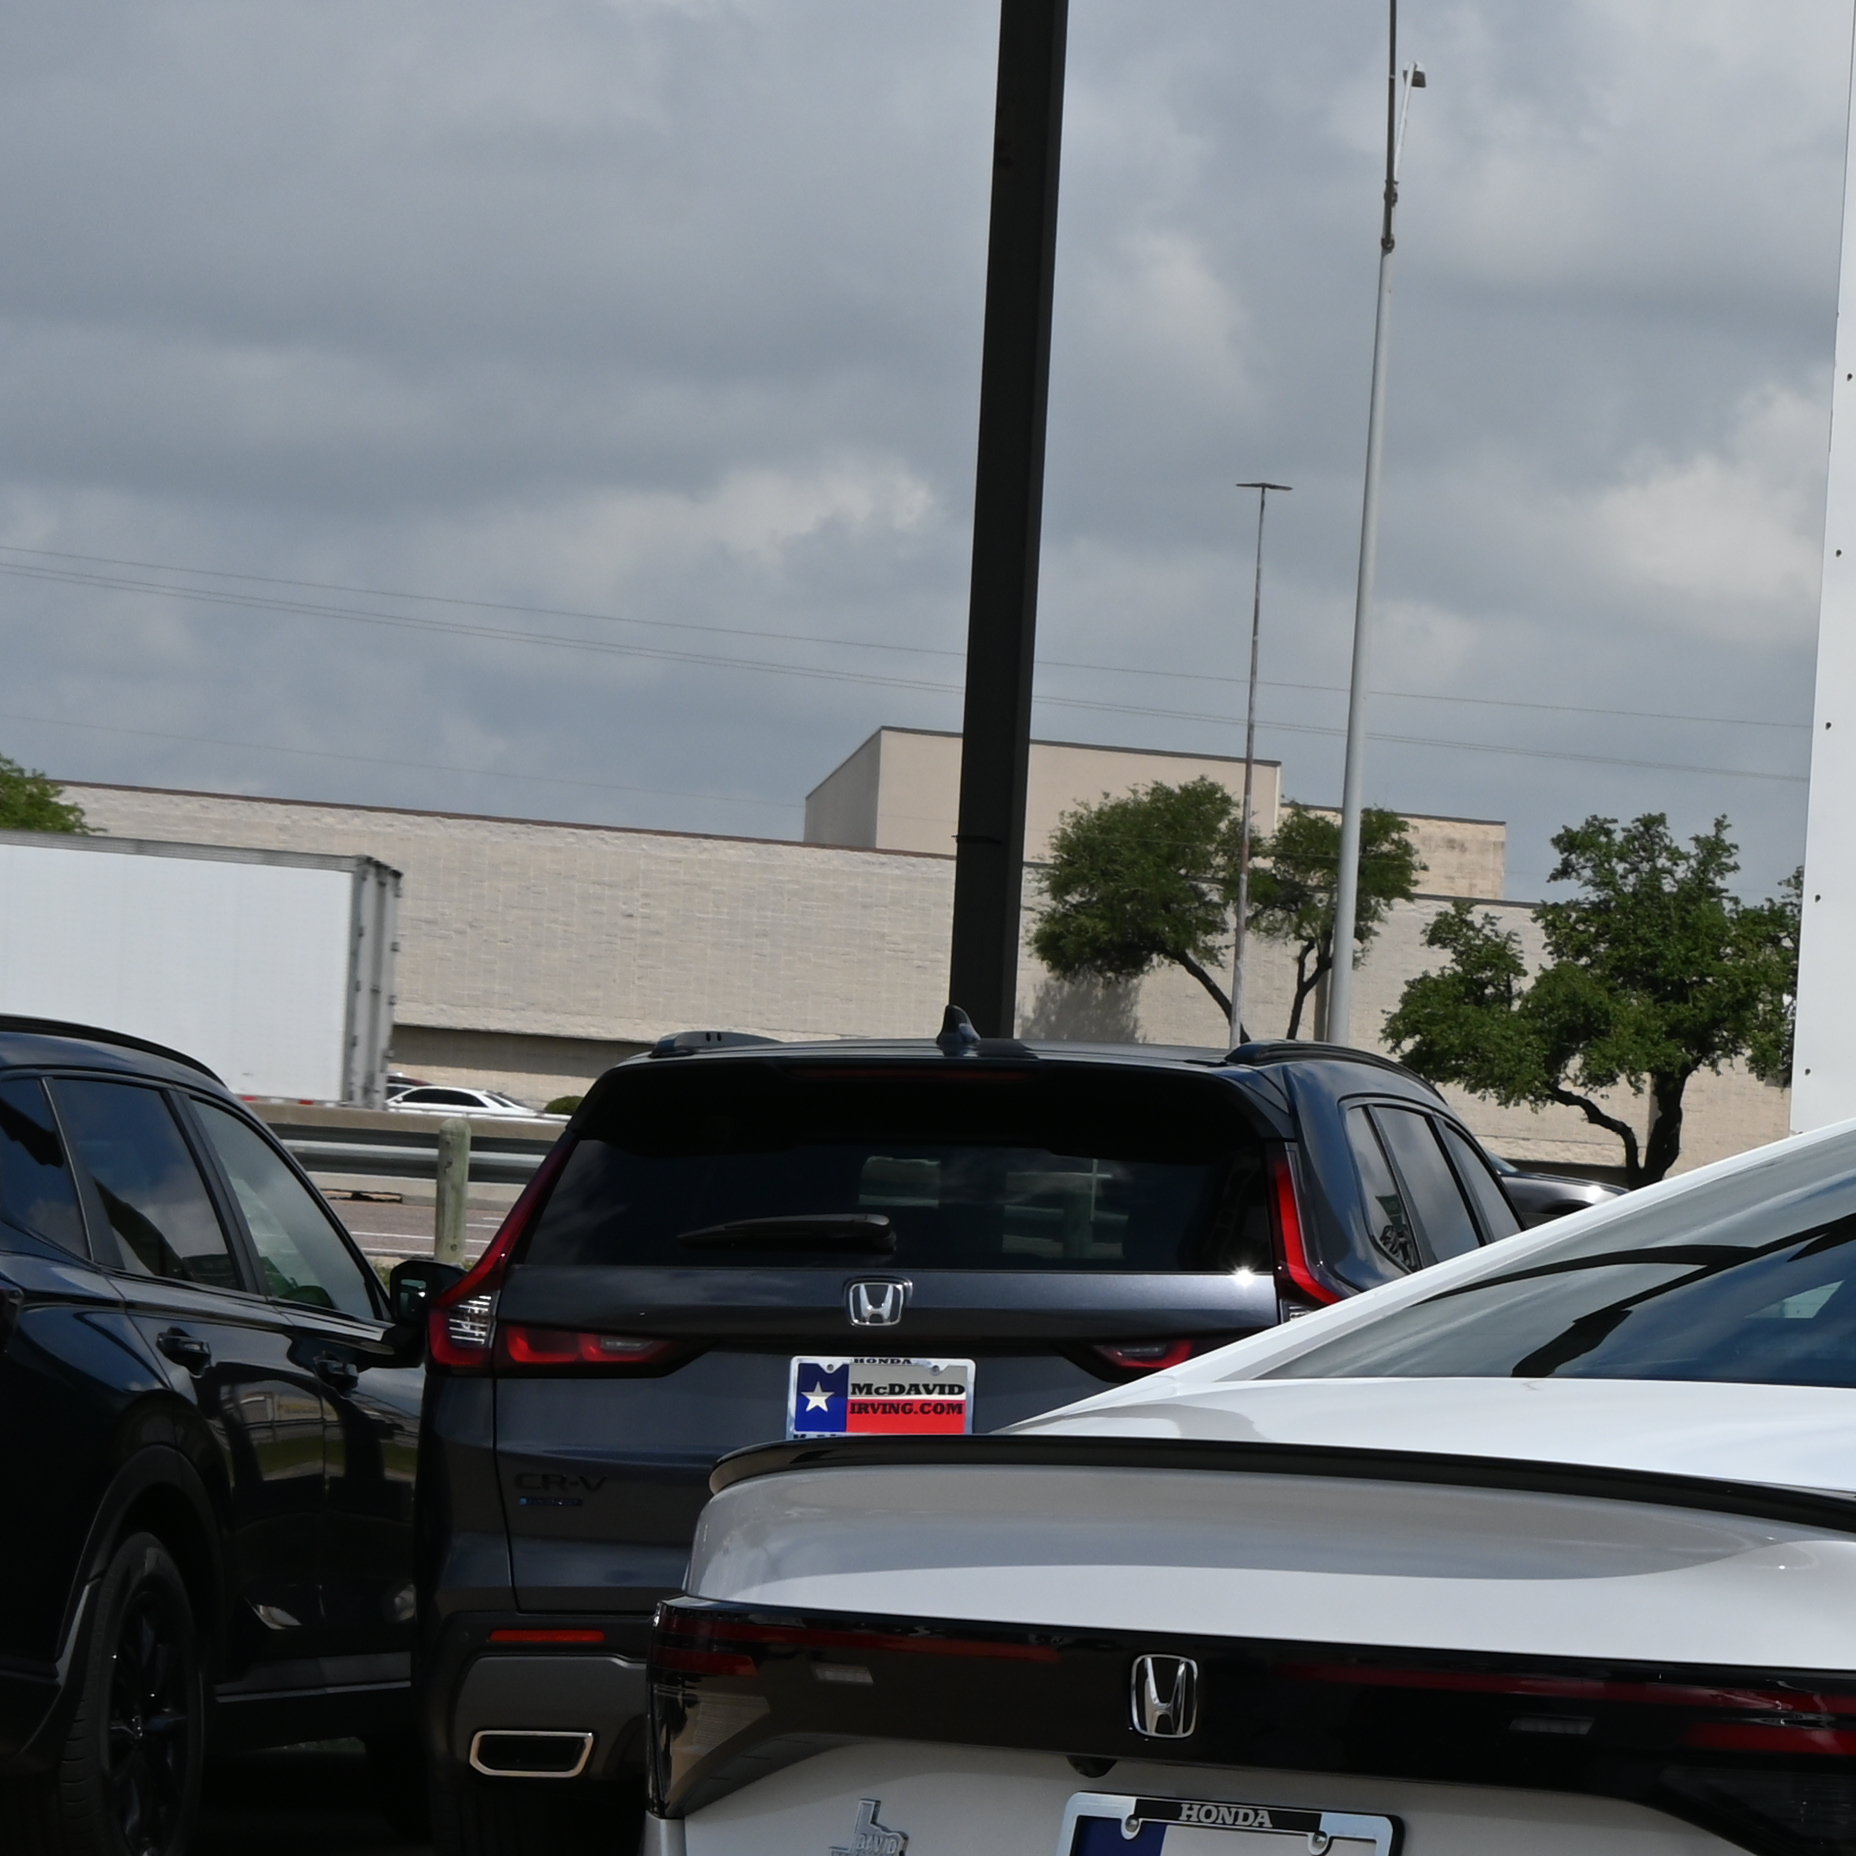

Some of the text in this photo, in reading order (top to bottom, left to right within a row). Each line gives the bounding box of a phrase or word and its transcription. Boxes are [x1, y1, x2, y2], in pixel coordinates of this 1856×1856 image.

[851, 1383, 965, 1396] McDAVID
[850, 1402, 963, 1415] IRVING.COM
[514, 1473, 608, 1492] CR-V
[1179, 1803, 1273, 1829] HONDA
